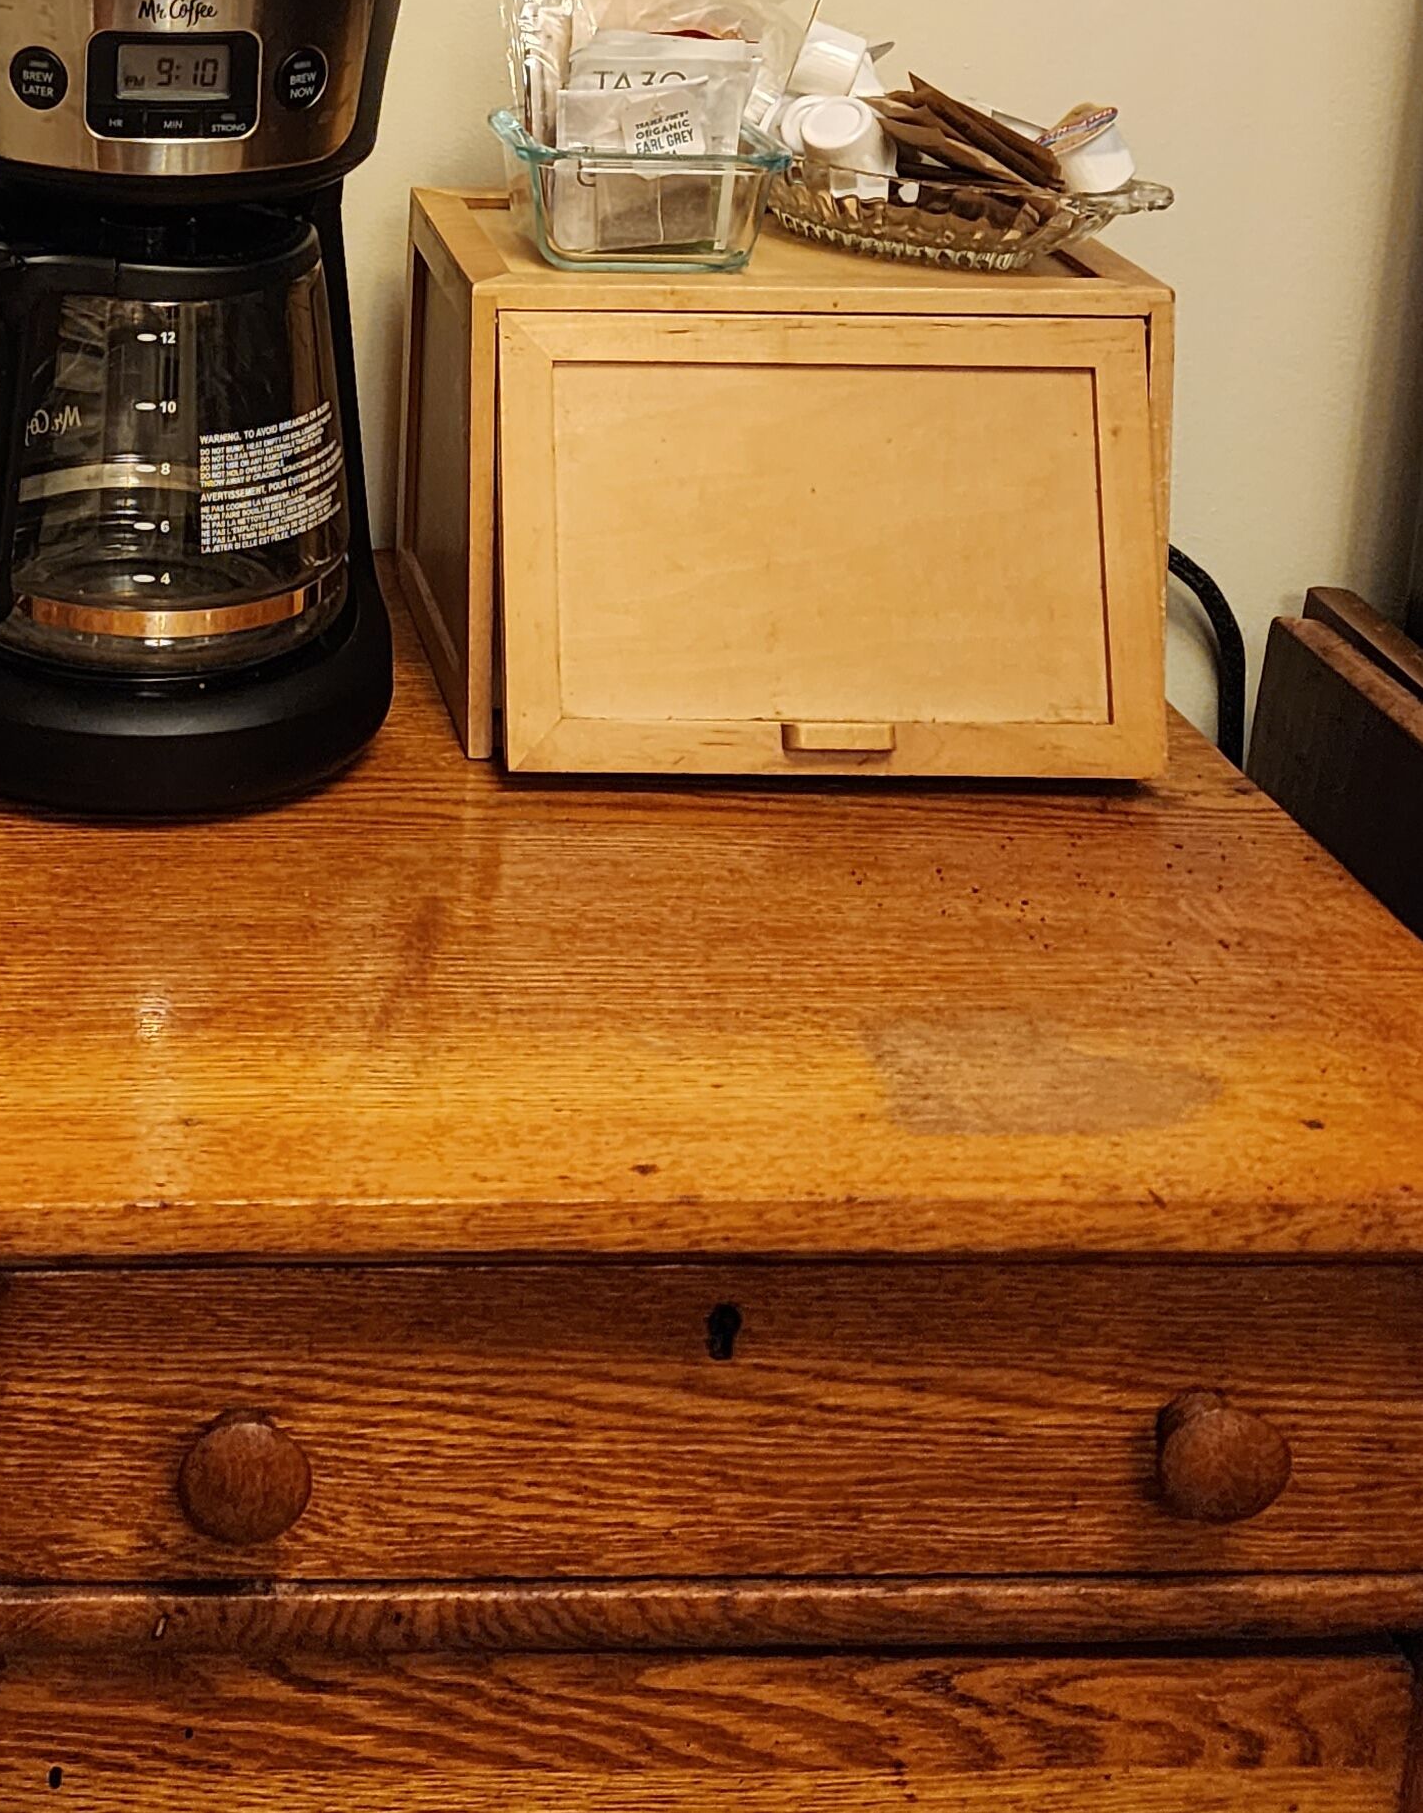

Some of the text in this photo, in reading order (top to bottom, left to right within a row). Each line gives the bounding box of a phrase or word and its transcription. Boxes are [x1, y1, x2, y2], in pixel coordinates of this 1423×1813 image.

[22, 69, 54, 84] BREW
[123, 57, 219, 87] PM 9:10
[289, 70, 317, 86] BREW
[22, 82, 55, 98] LATER
[289, 84, 315, 100] NOW
[108, 118, 124, 128] HR
[162, 119, 183, 130] MIN
[210, 122, 247, 133] STRONG
[635, 118, 690, 141] ORGANIC
[666, 128, 694, 148] GREY
[160, 331, 176, 345] 12
[159, 400, 177, 414] 10
[243, 429, 254, 439] TO
[256, 424, 278, 438] AVOID
[200, 448, 210, 456] DO
[212, 445, 225, 455] NOT
[212, 453, 225, 462] NOT
[160, 463, 171, 476] 8
[212, 462, 225, 471] NOT
[160, 521, 170, 534] 6
[200, 545, 211, 554] LA
[160, 572, 171, 585] 4
